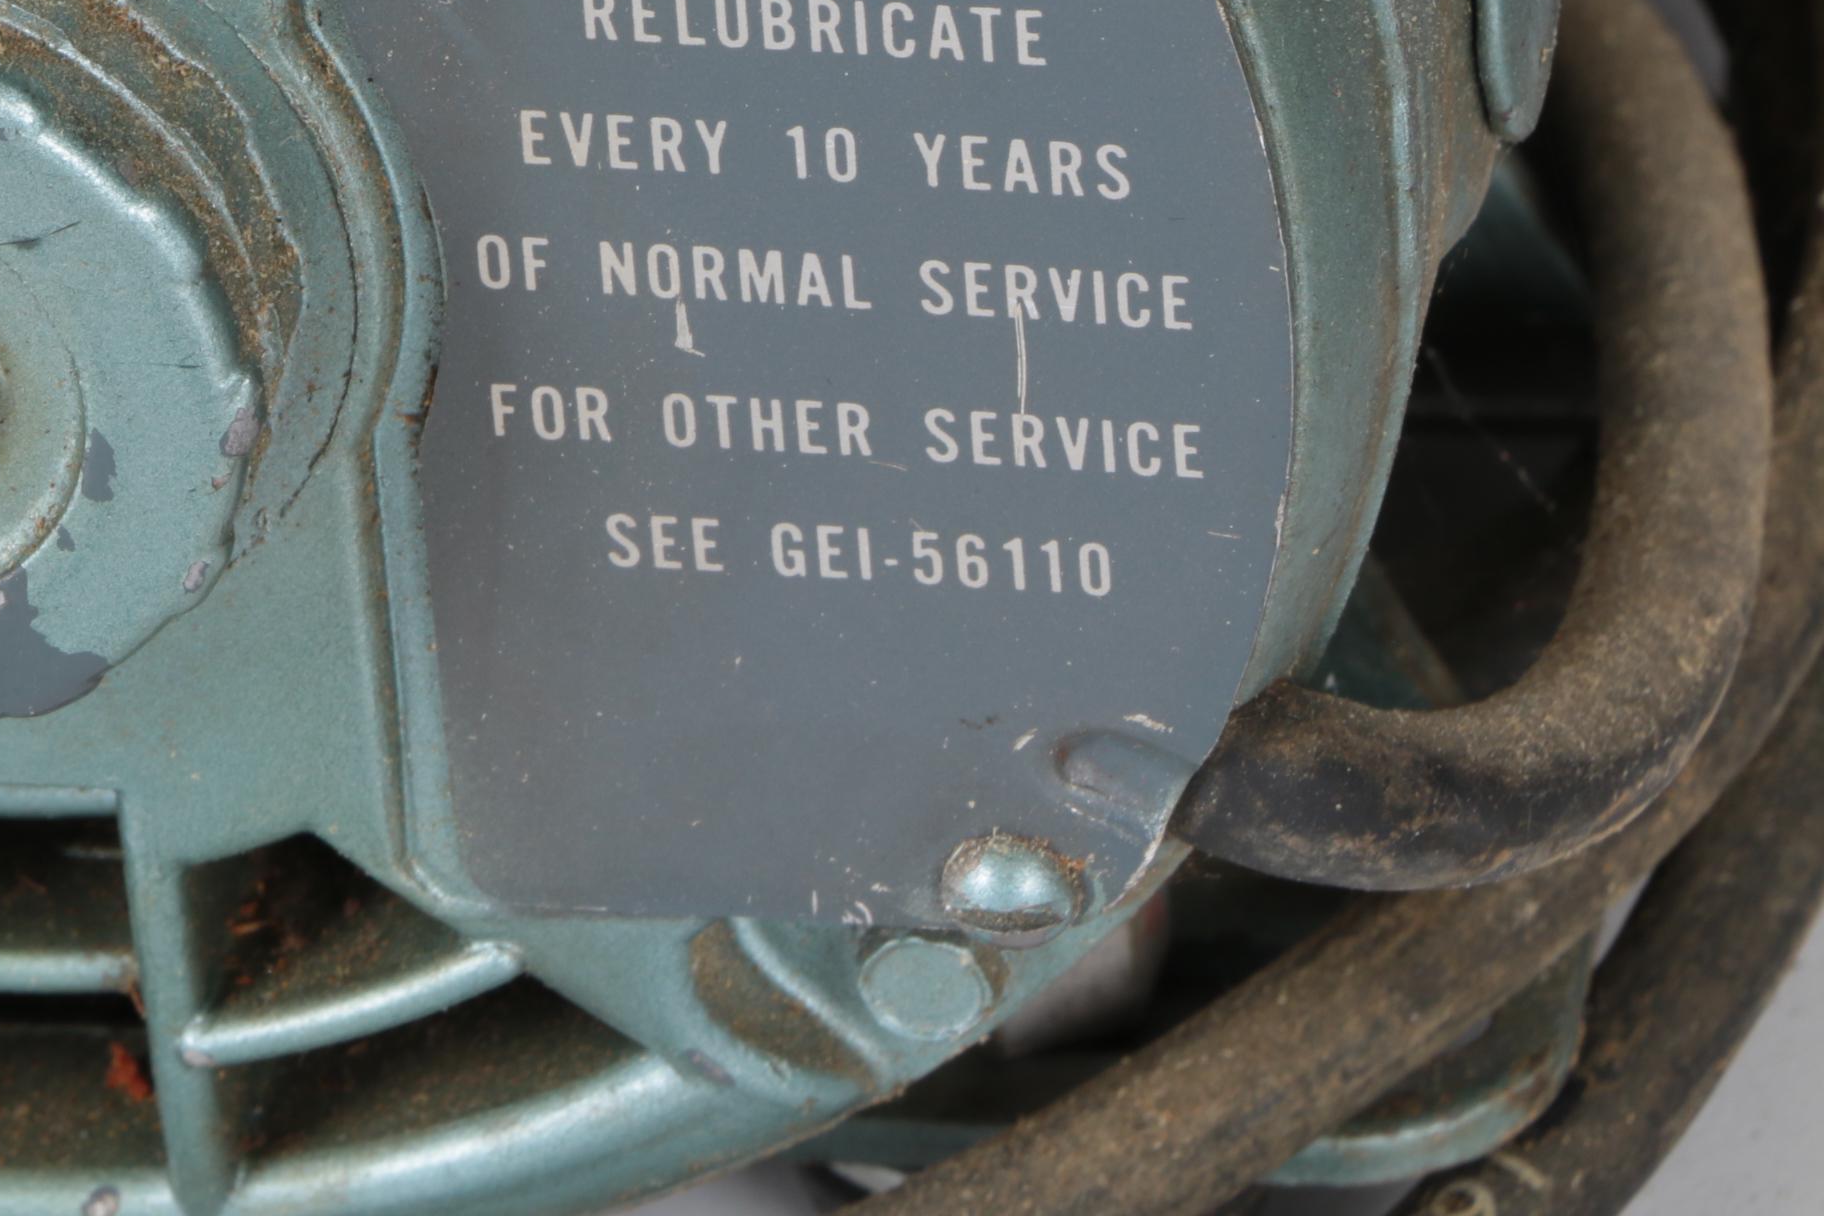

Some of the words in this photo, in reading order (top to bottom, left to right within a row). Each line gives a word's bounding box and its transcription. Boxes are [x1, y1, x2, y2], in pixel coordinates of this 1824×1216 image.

[519, 109, 728, 175] EVERY
[785, 126, 859, 183] 10
[913, 131, 1133, 201] YEARS
[475, 233, 549, 292] OF
[598, 241, 873, 310] NORMAL
[918, 259, 1194, 331] SERVICE
[489, 382, 613, 443] FOR
[662, 392, 873, 457] OTHER
[923, 407, 1206, 480] SERVICE
[605, 512, 725, 573] SEE
[770, 521, 1114, 597] GEI-56110
